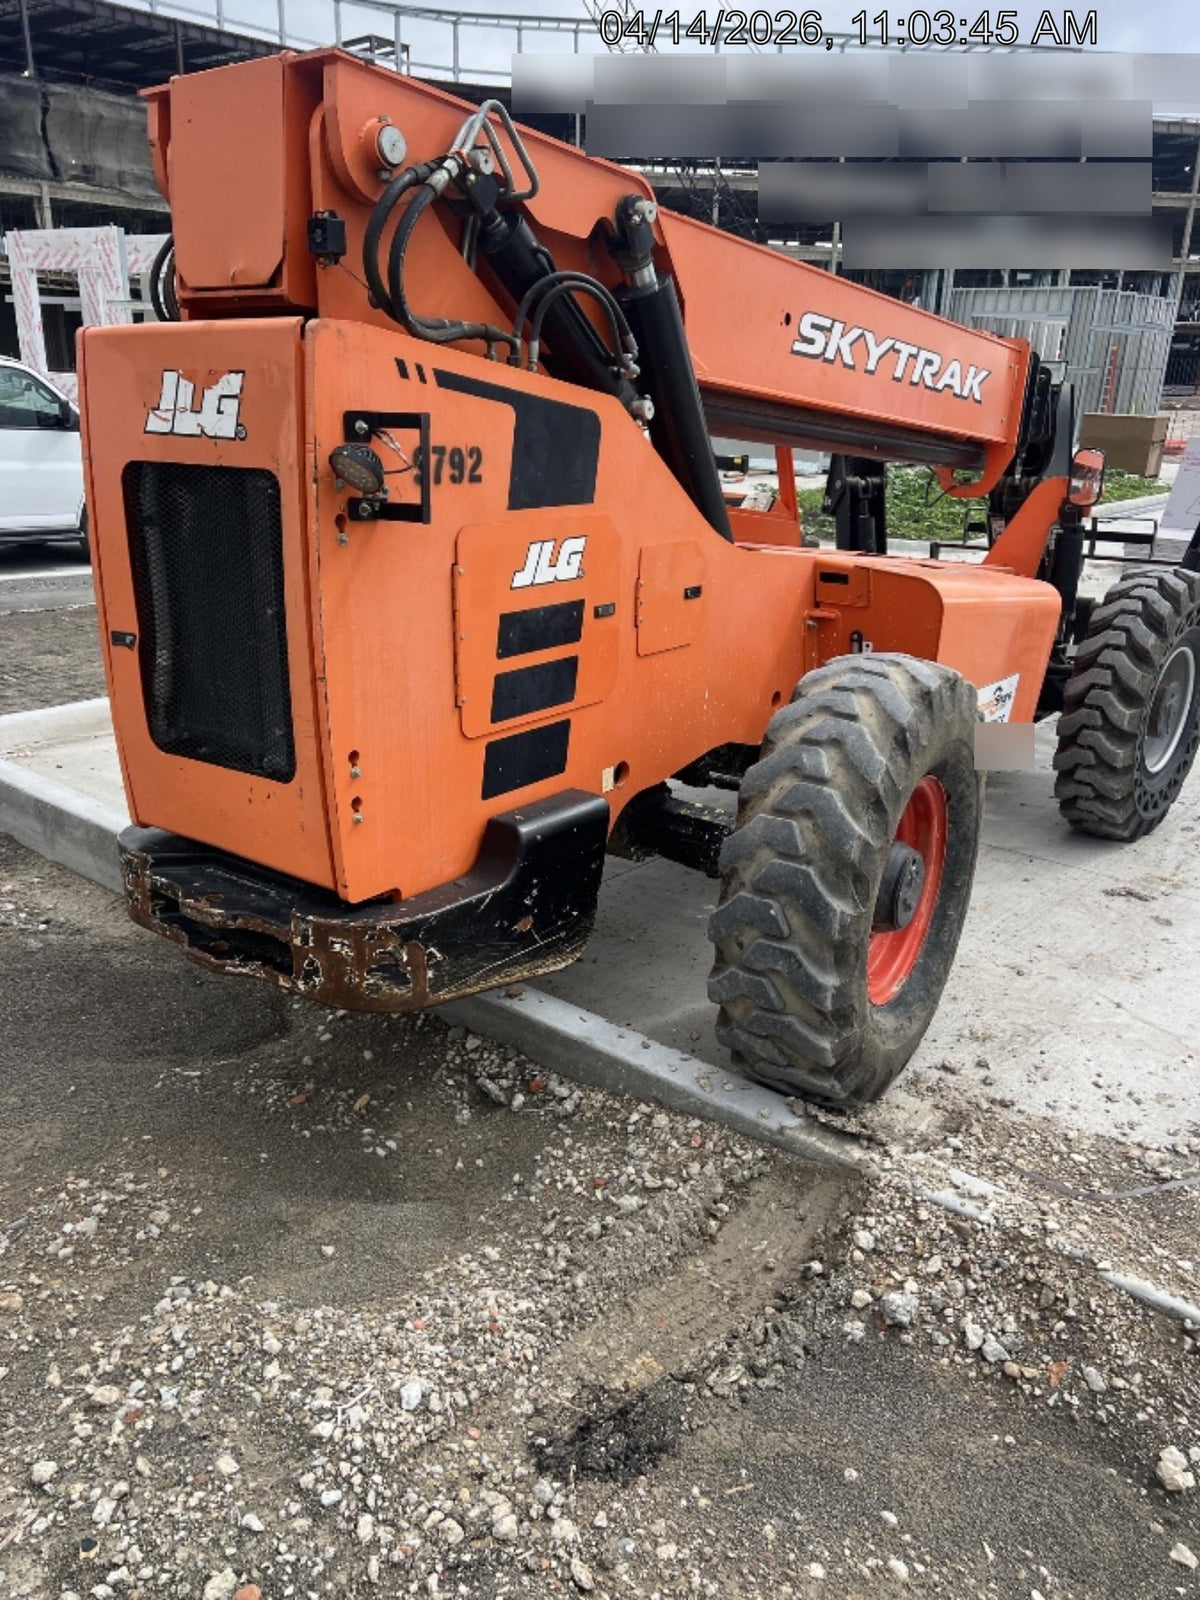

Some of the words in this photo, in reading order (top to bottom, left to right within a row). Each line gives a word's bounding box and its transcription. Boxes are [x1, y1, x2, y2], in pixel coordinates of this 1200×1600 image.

[791, 311, 991, 403] SKYTRAK
[144, 369, 246, 440] JLG
[510, 535, 588, 590] JLG
